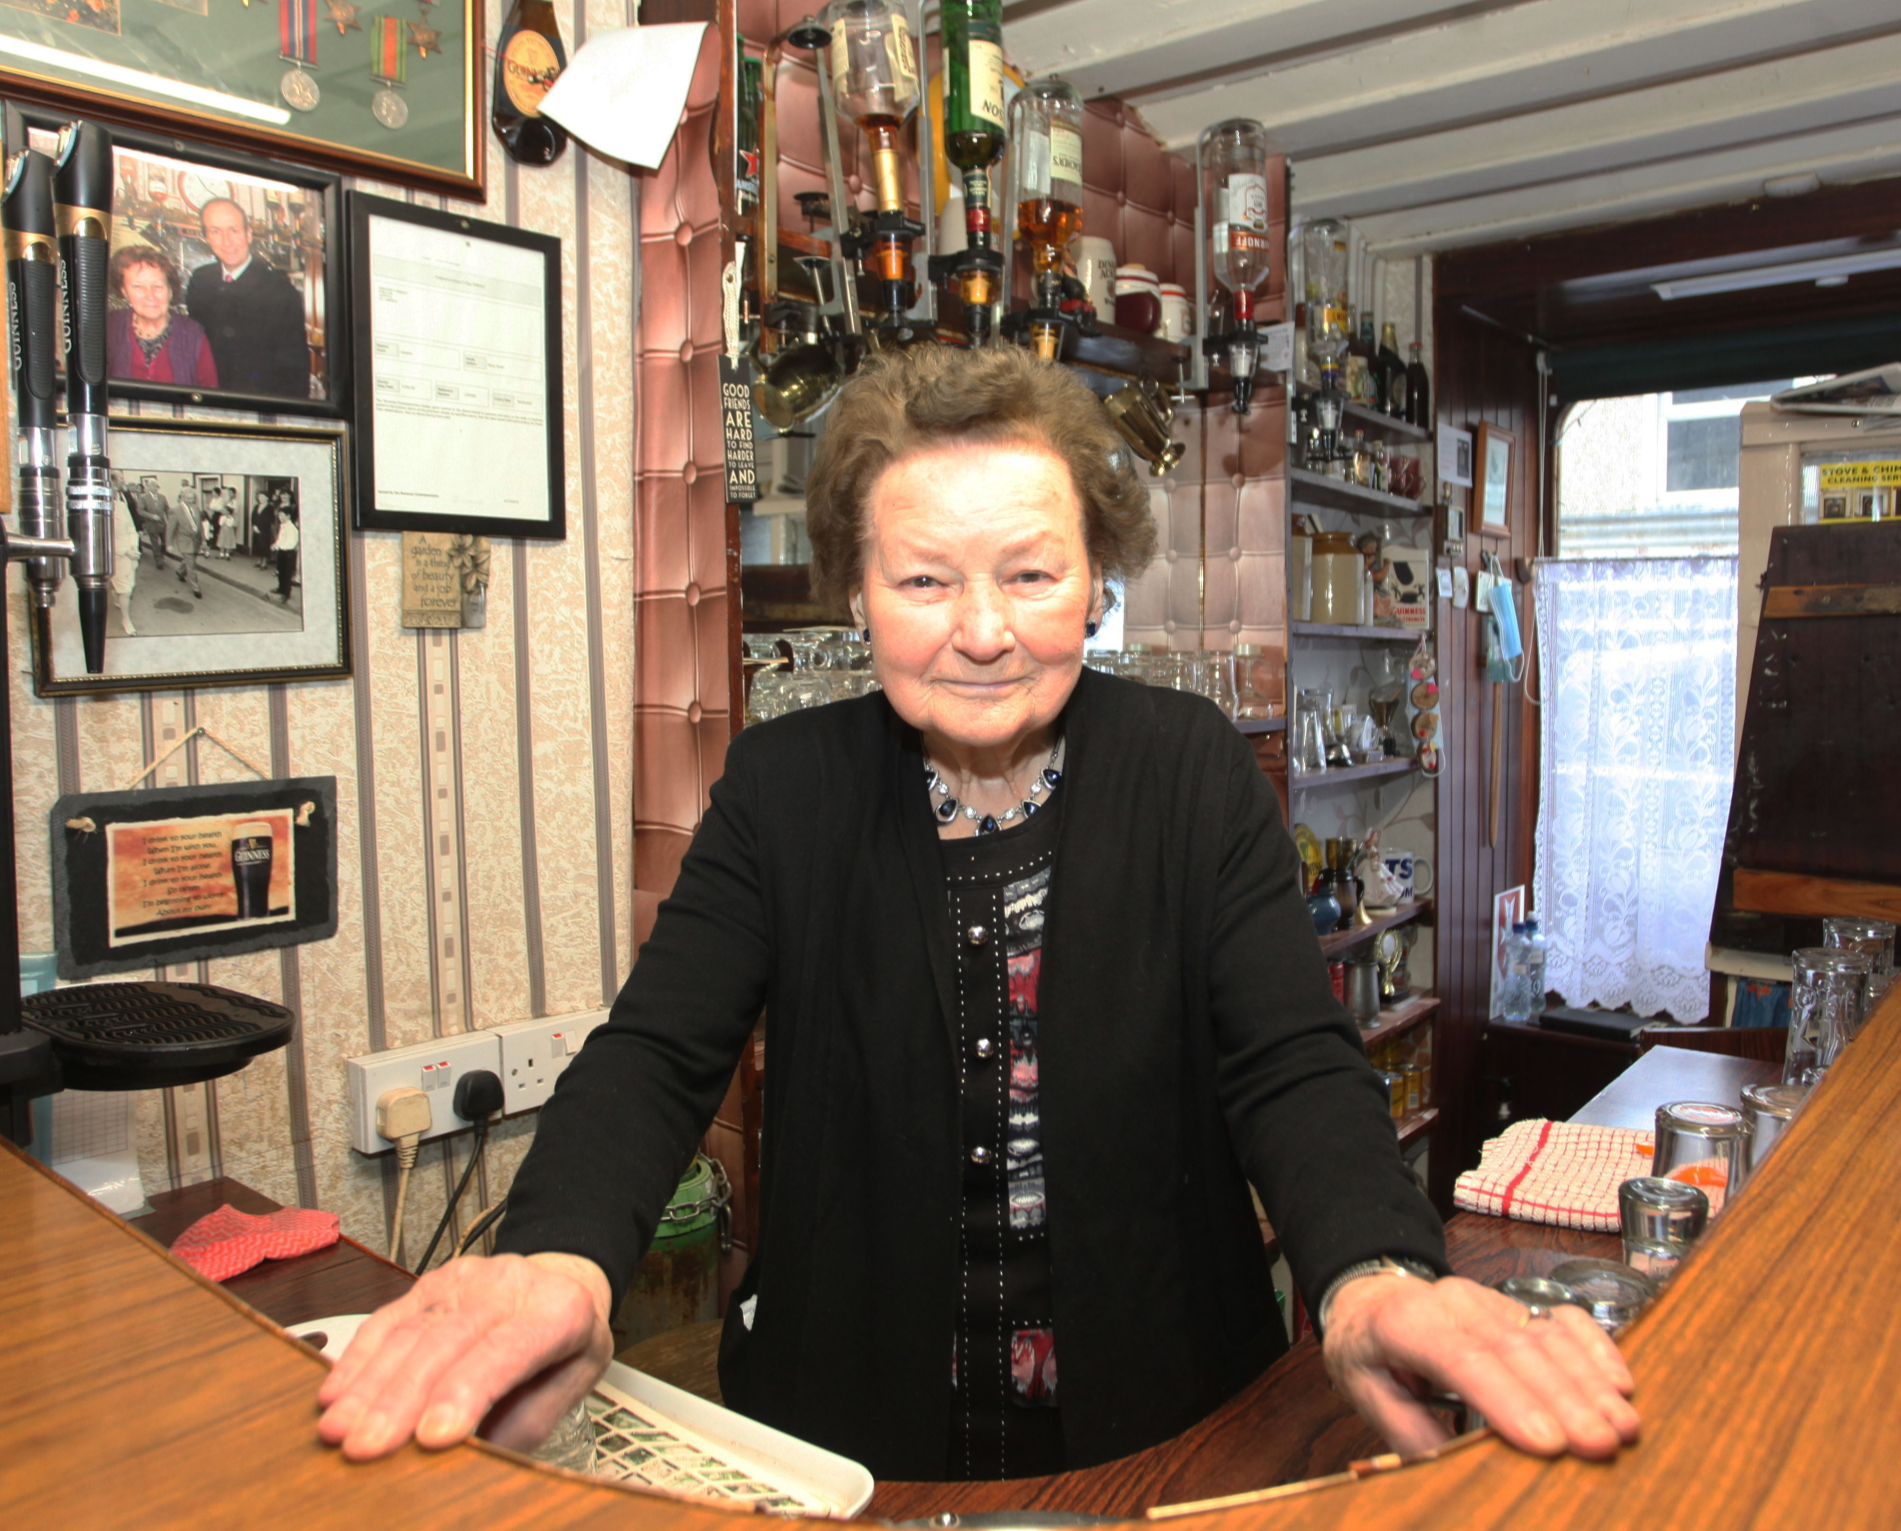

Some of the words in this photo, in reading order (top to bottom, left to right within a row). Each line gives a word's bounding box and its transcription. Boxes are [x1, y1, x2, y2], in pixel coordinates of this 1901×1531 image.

[60, 259, 72, 354] GUINNESS
[8, 281, 22, 371] GUINNESS
[723, 383, 750, 398] GOOD
[724, 397, 751, 410] FRIENDS
[726, 411, 752, 428] ARE
[726, 427, 753, 441] HARD
[727, 441, 737, 449] TO
[739, 441, 753, 450] FIND
[727, 450, 754, 461] HARDER
[728, 461, 737, 469] TO
[738, 461, 755, 469] LEAVE
[1822, 466, 1857, 477] STOVE
[1862, 466, 1868, 474] &
[729, 469, 755, 485] AND
[1828, 475, 1879, 484] CLEANING
[730, 491, 737, 499] TO
[738, 491, 756, 499] FORGET
[420, 535, 426, 544] A
[411, 545, 442, 559] garden
[430, 558, 450, 570] thing
[411, 569, 421, 580] of
[422, 568, 455, 582] beauty
[413, 583, 428, 592] and
[437, 583, 452, 597] job
[420, 593, 456, 607] forever
[234, 849, 271, 863] GUINNESS
